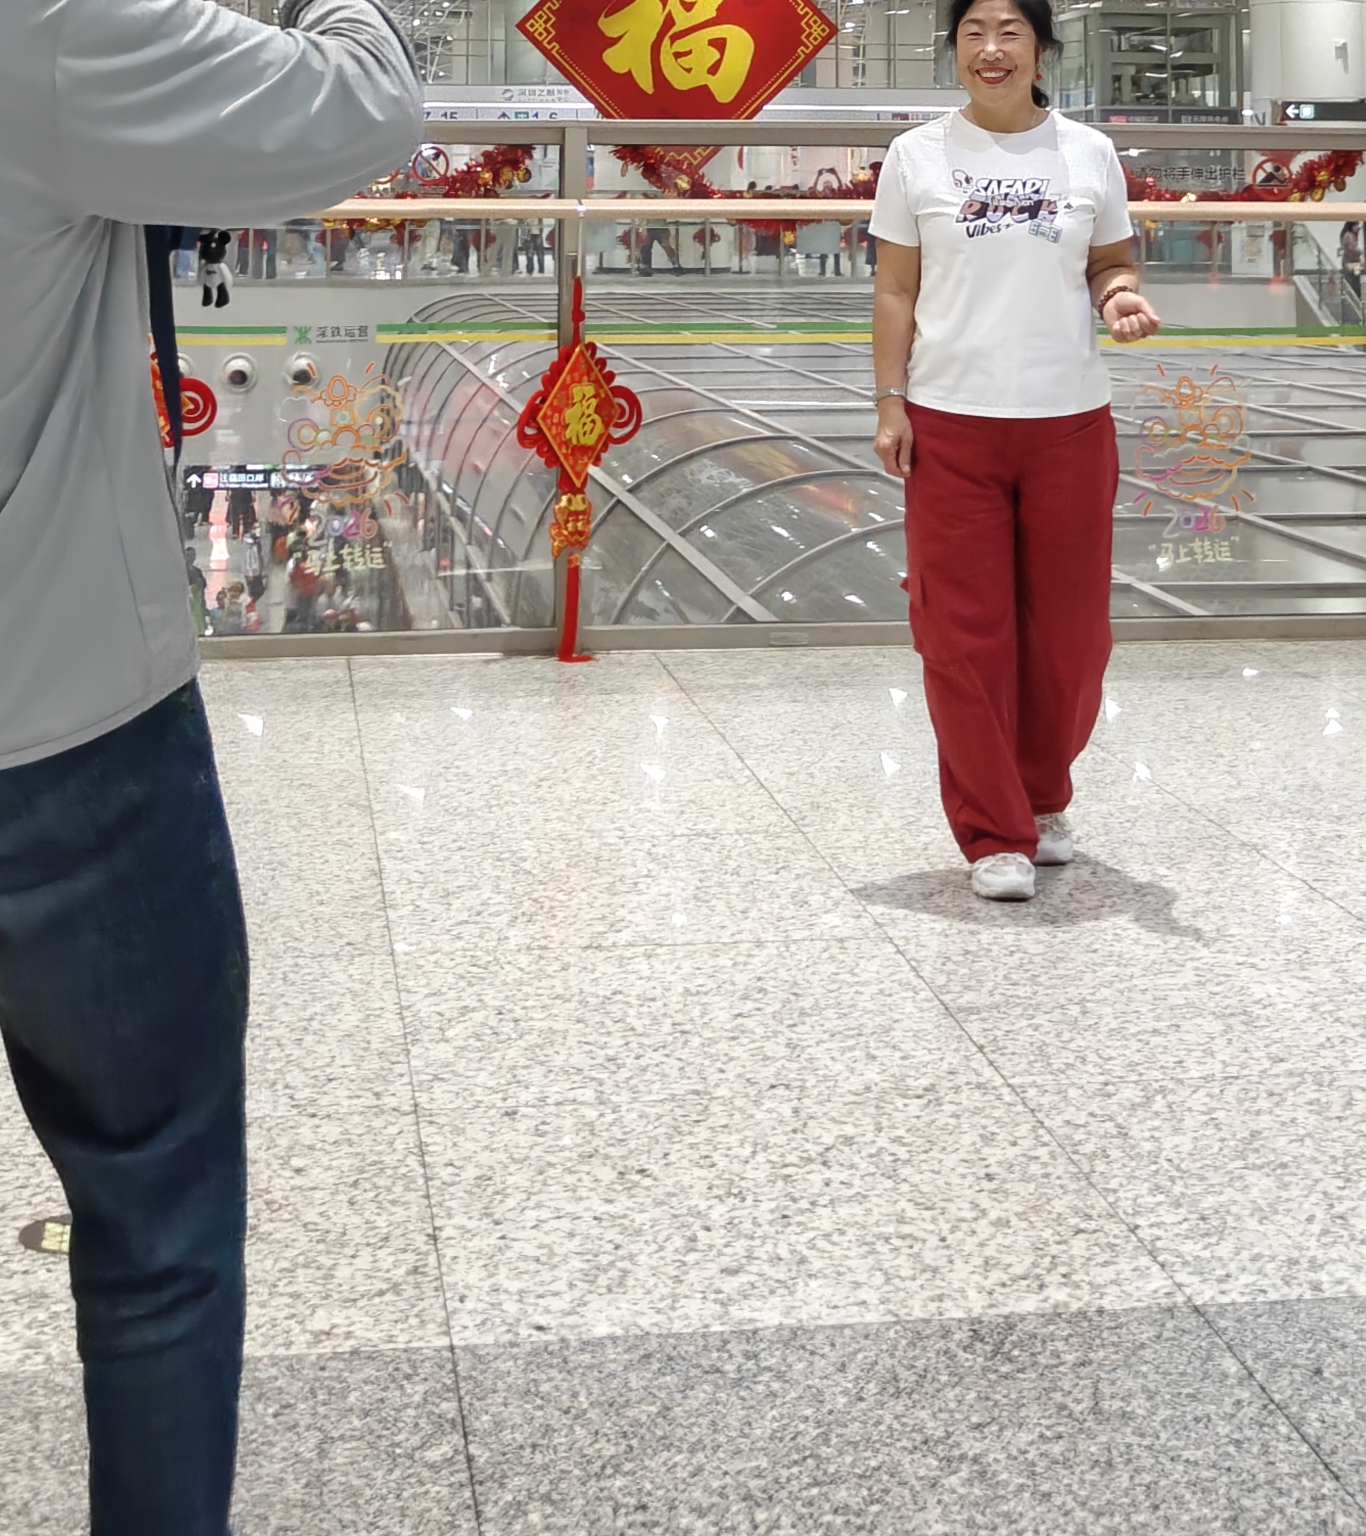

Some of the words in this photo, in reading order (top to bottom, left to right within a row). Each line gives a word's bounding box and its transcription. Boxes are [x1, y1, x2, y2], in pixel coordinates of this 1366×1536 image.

[966, 222, 1003, 239] Vibes
[564, 384, 602, 446] 福
[308, 508, 378, 547] 2026
[1162, 505, 1226, 539] 2026
